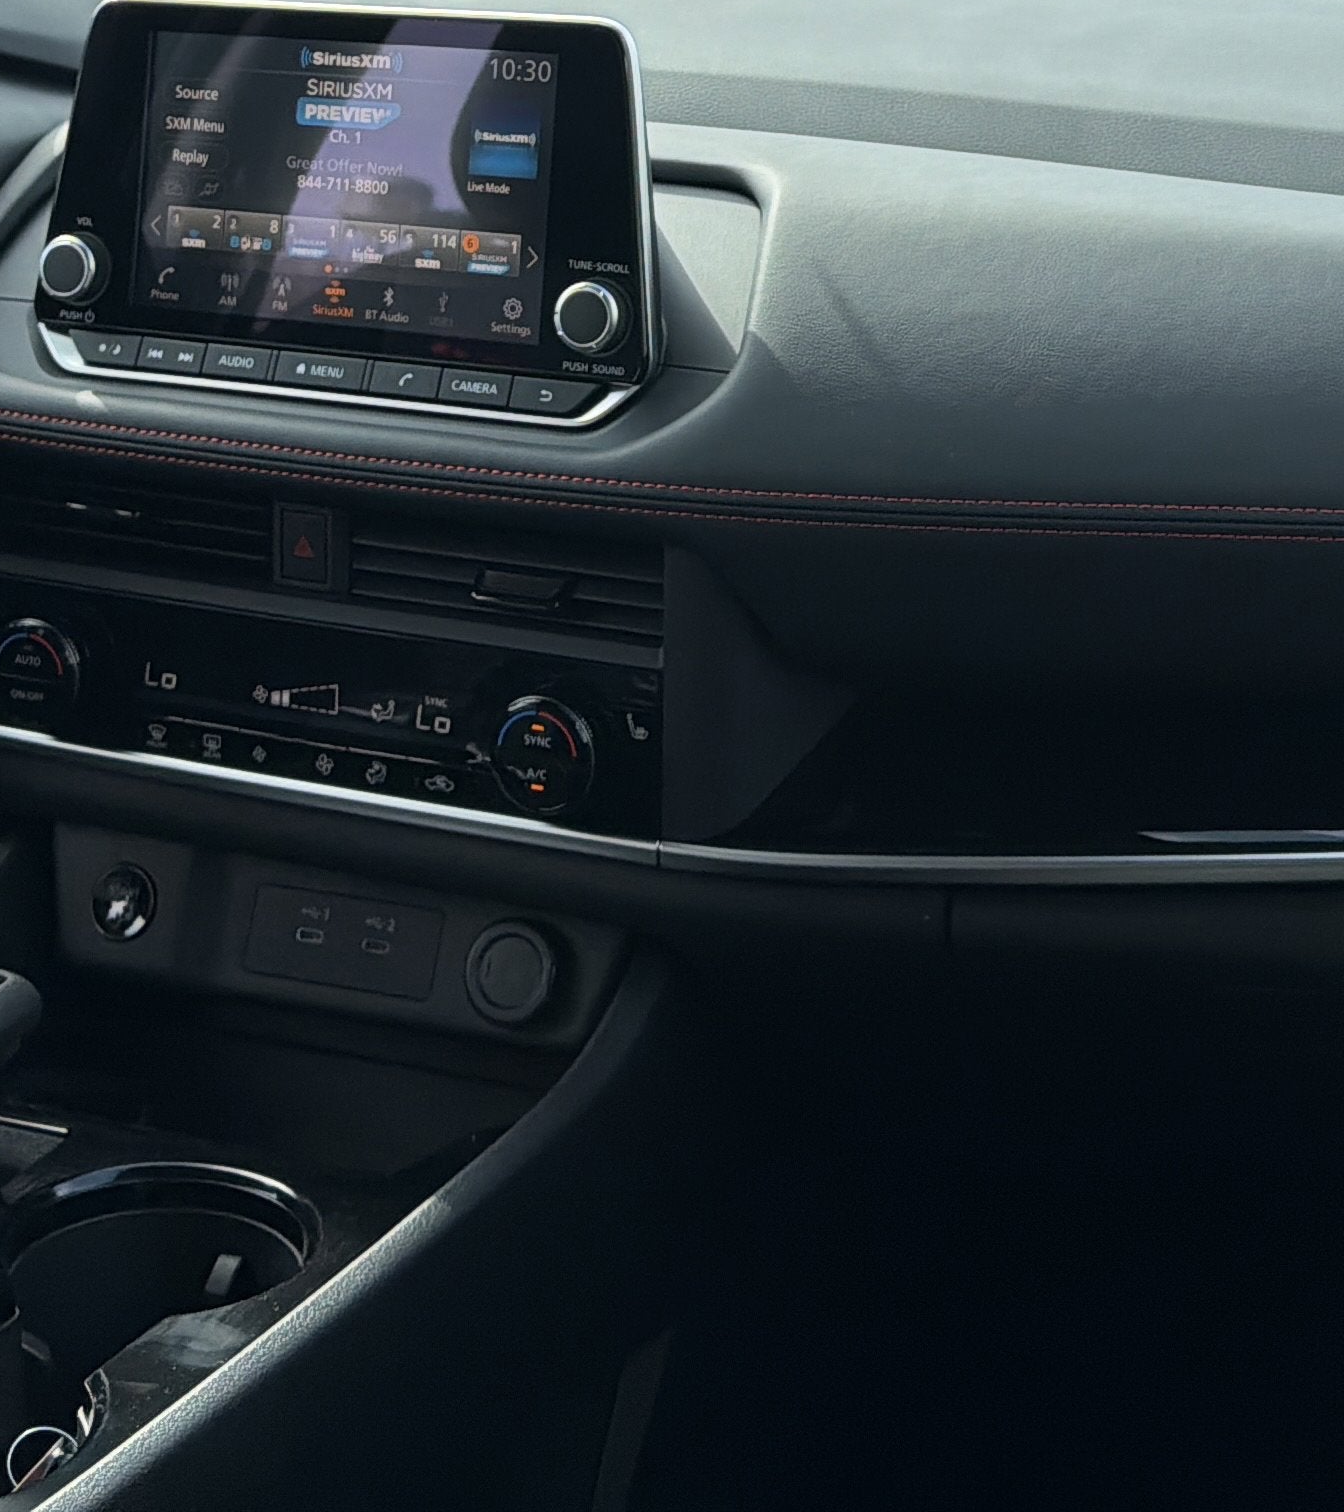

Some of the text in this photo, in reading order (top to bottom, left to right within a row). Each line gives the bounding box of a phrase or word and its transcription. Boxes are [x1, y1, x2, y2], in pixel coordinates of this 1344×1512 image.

[491, 58, 552, 82] 10:30
[175, 85, 219, 101] Source
[307, 79, 392, 100] SIRIUSXM
[305, 103, 392, 123] PREVIEW
[165, 116, 224, 133] SXM Menu
[329, 129, 361, 144] Ch. 1
[172, 148, 208, 167] Replay
[286, 156, 403, 177] Great Offer Now!
[297, 175, 388, 194] 844-711-8800
[467, 181, 510, 194] Live Mode
[76, 216, 93, 227] VOL
[212, 215, 221, 229] 2
[230, 218, 279, 233] 2 8
[329, 225, 336, 237] 1
[379, 229, 397, 244] 56
[433, 234, 456, 248] 114
[511, 240, 518, 255] 1
[415, 258, 441, 269] sxm
[59, 309, 83, 321] PUSH
[150, 289, 179, 301] Phone
[218, 296, 237, 306] AM
[272, 301, 288, 311] FM
[313, 304, 354, 318] SiriusXM
[365, 309, 377, 320] BT
[379, 311, 409, 323] Audio
[491, 322, 531, 337] Settings
[219, 354, 498, 395] AUDIO MENU CAMERA
[562, 361, 626, 377] PUSH SOUND
[15, 654, 42, 668] AUTO
[145, 661, 177, 689] Lo
[424, 695, 449, 708] SYNC
[416, 704, 452, 734] Lo
[524, 734, 552, 749] SYNC
[527, 768, 547, 780] A/C
